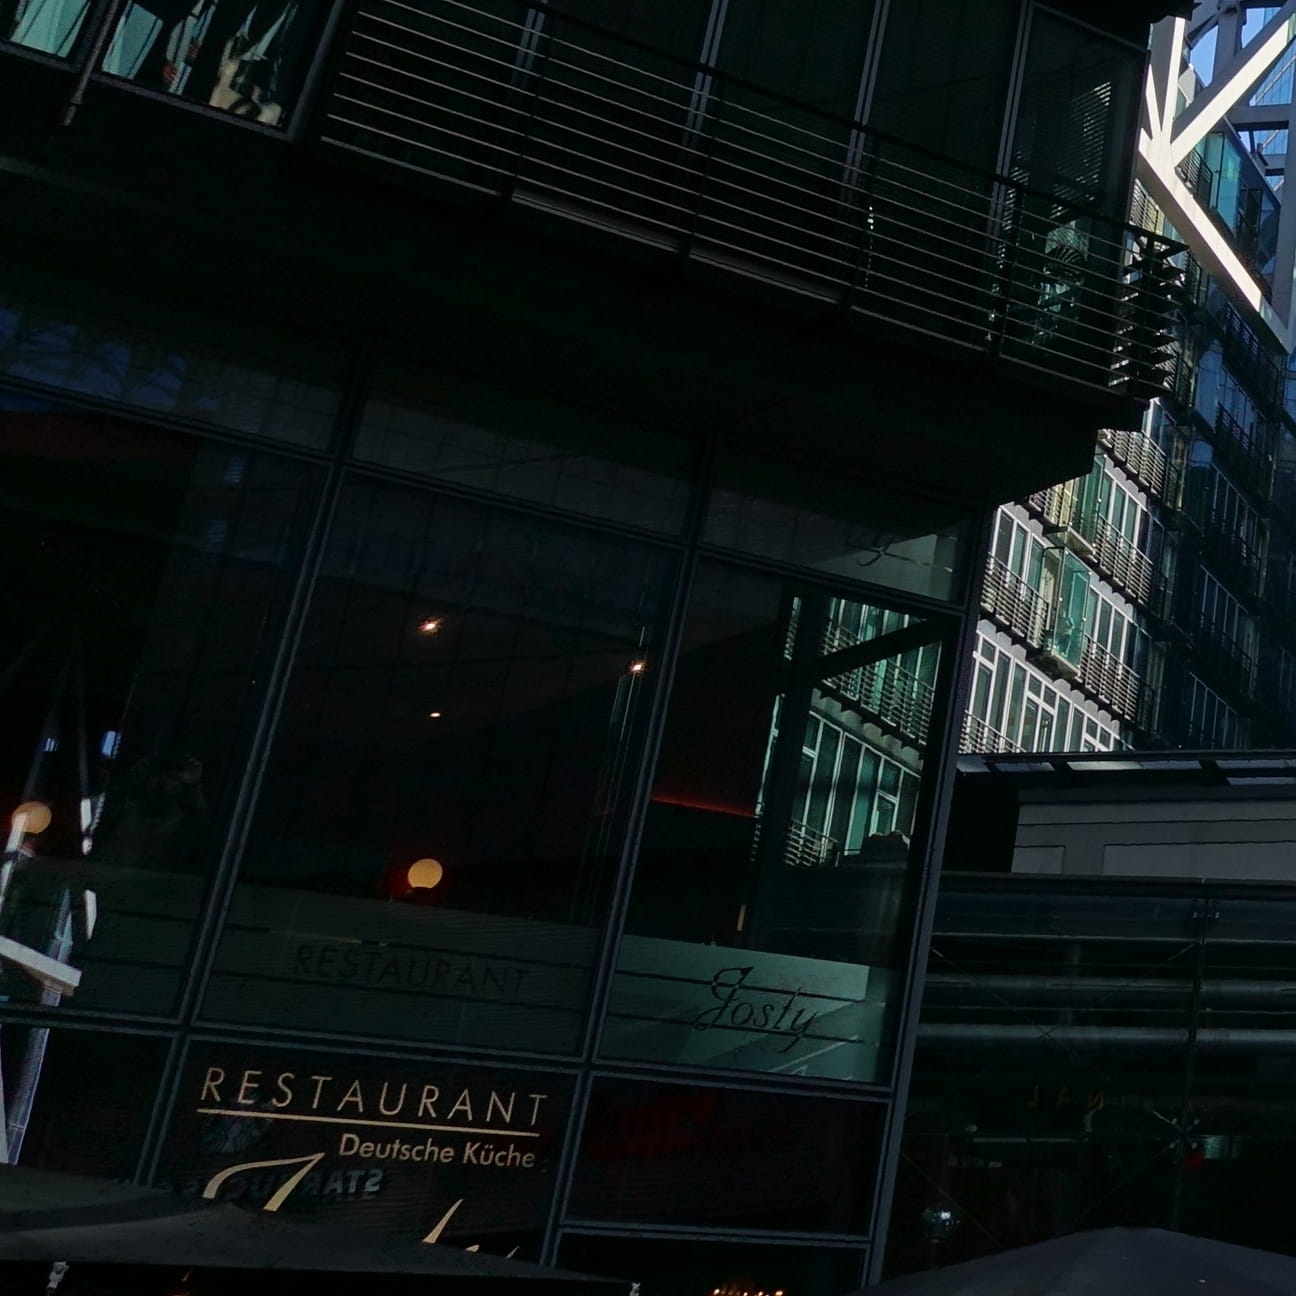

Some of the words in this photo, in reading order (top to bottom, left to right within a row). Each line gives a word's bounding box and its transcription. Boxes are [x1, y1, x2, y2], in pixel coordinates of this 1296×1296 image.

[294, 943, 529, 1000] RESTAURANT
[693, 966, 817, 1054] Josty
[200, 1067, 548, 1127] RESTAURANT
[338, 1132, 454, 1164] Deutsche
[463, 1141, 536, 1168] Küche
